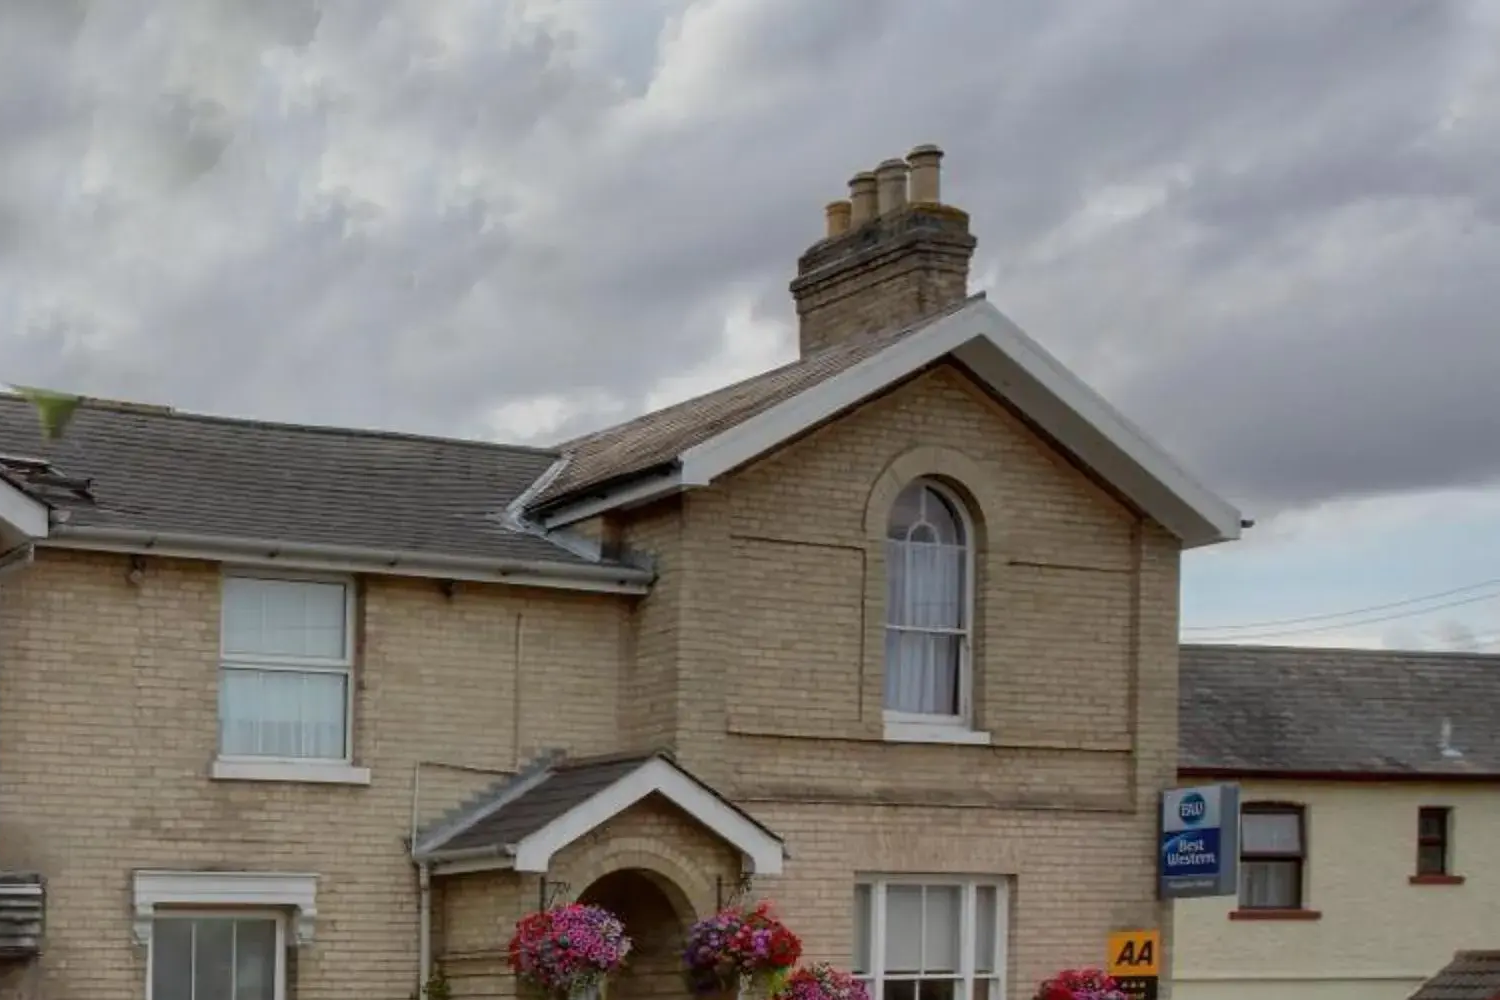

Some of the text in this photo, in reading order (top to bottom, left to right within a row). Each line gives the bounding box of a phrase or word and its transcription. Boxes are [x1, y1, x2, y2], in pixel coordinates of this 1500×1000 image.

[1180, 839, 1205, 852] Best
[1167, 852, 1216, 866] Western
[1115, 940, 1153, 967] AA
